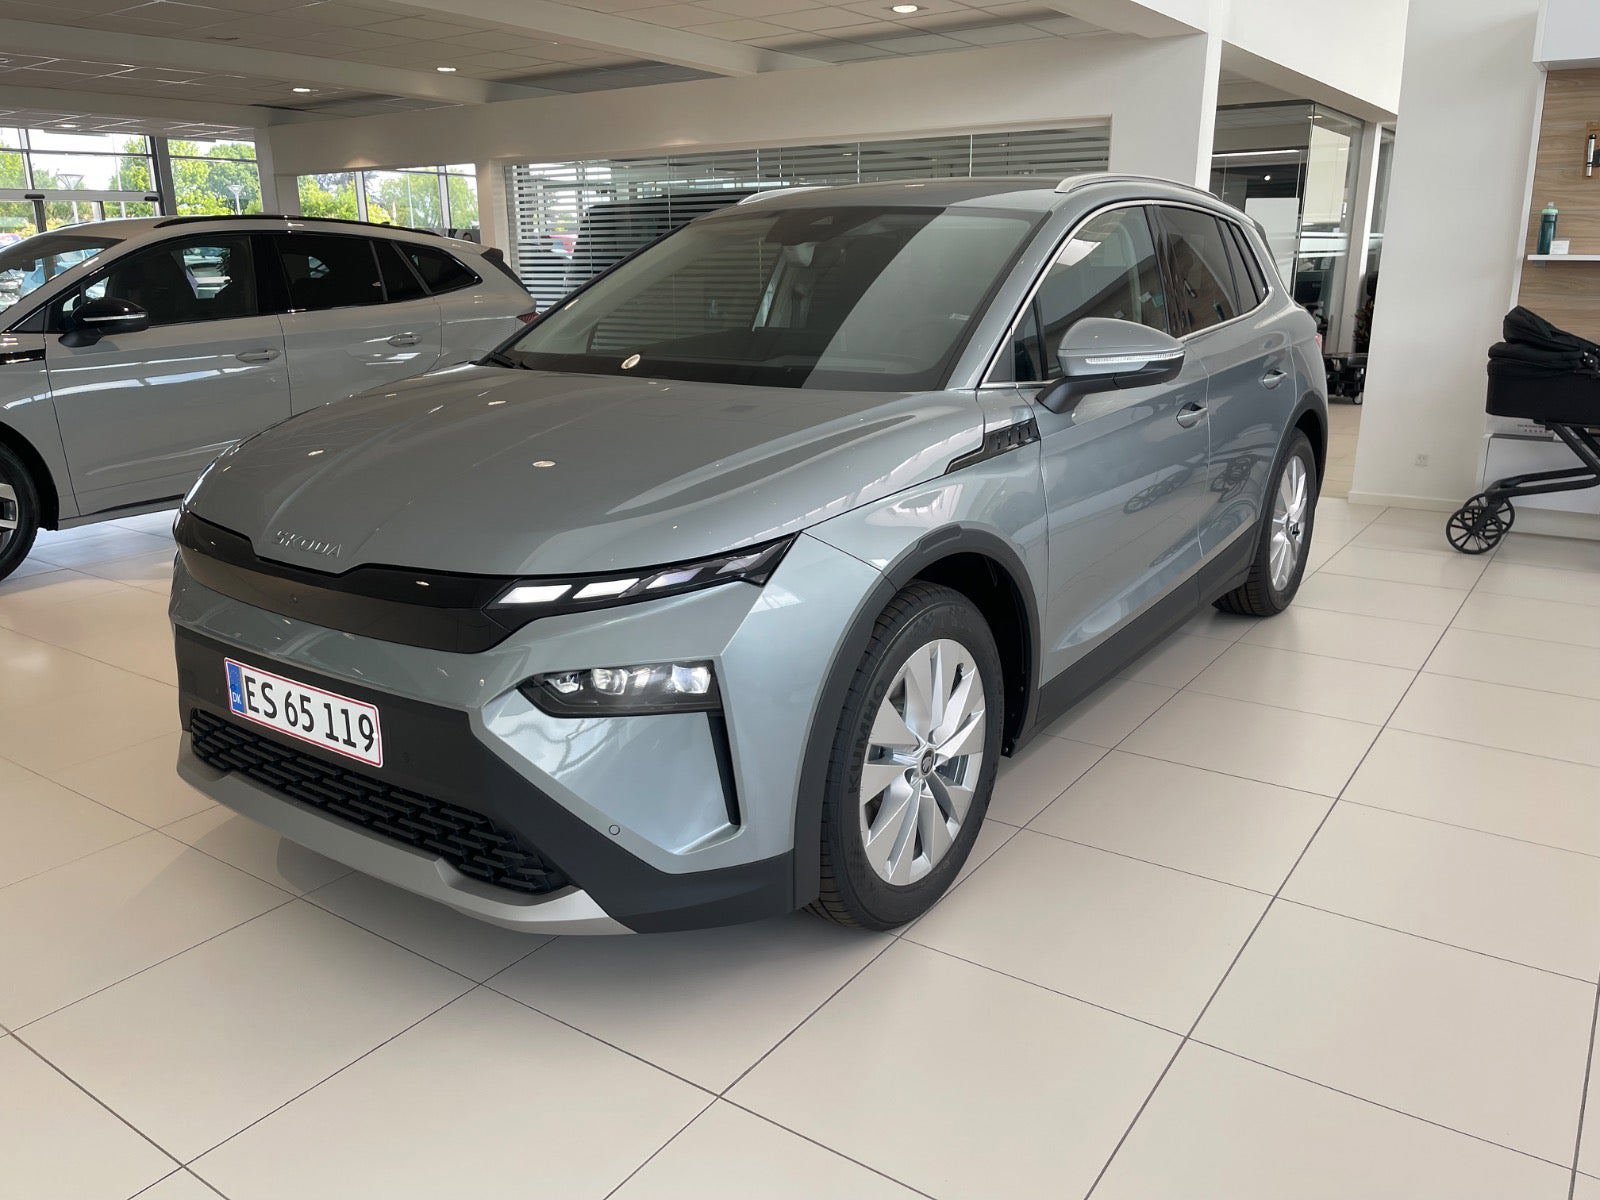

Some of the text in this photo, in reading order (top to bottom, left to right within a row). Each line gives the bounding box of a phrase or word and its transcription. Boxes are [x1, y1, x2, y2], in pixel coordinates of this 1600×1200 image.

[232, 691, 242, 704] DK
[244, 675, 374, 752] ES 65 119
[848, 681, 887, 794] KUMHO
